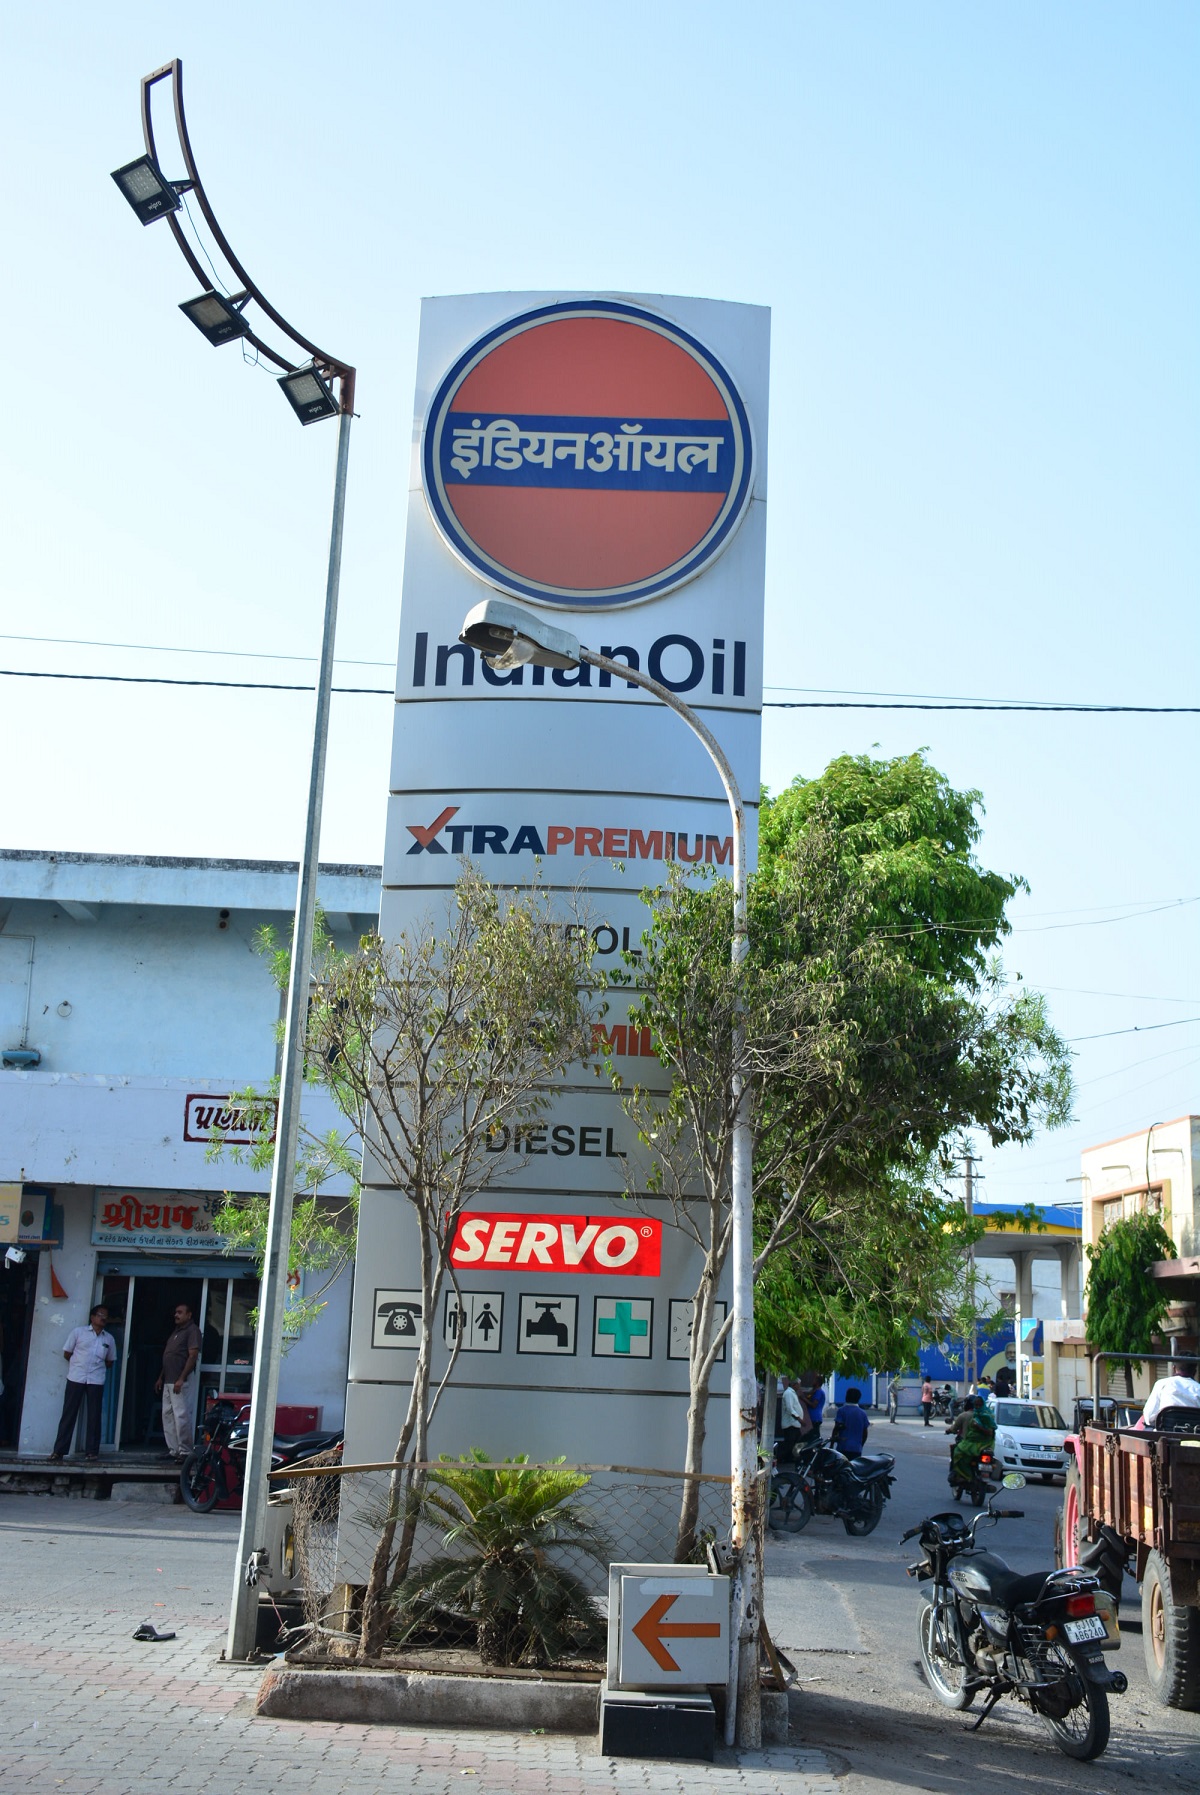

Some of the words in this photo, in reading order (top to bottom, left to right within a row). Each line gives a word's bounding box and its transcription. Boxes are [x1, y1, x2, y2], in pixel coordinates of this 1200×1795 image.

[450, 418, 725, 480] इंडियनऑयल
[485, 1124, 627, 1158] DIESEL
[101, 1195, 199, 1231] શ્રીરાજ
[453, 1219, 639, 1268] SERVO
